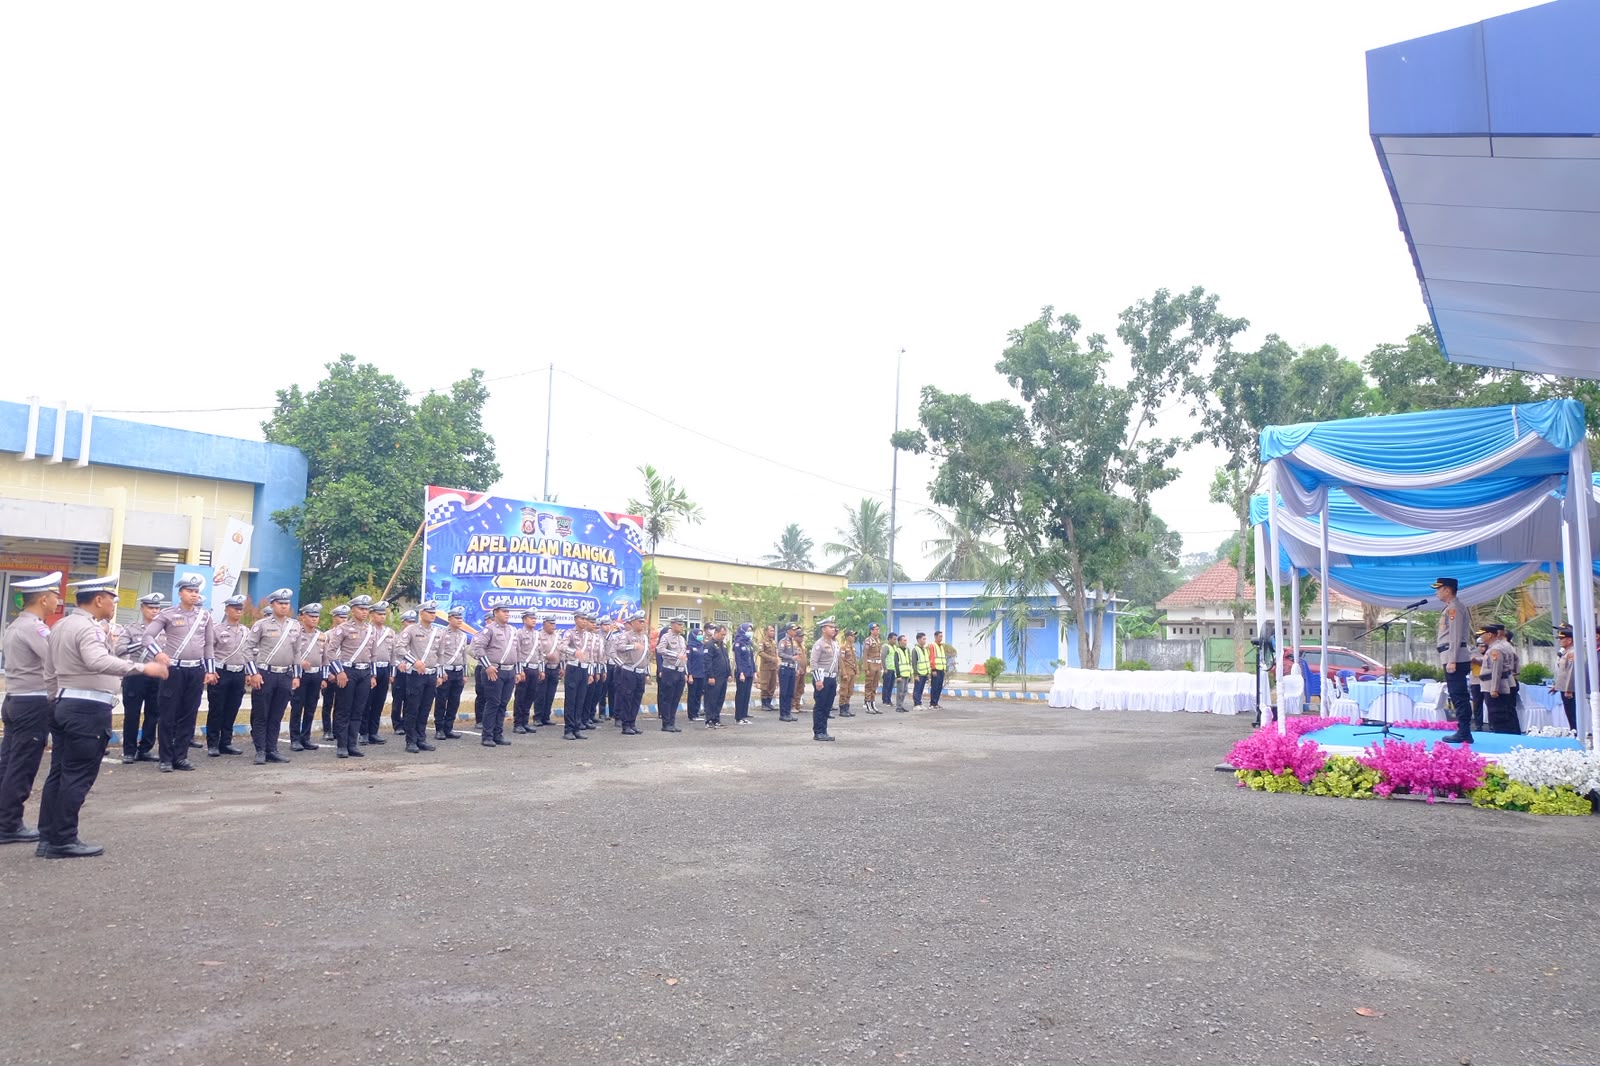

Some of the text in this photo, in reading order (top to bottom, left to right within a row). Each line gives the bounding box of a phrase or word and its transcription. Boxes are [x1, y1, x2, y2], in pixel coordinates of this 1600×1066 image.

[466, 535, 616, 566] APEL DALAM RANGKA
[452, 555, 624, 587] HARI LALU LINTAS KE 71
[515, 578, 573, 590] TAHUN 2026
[487, 595, 595, 610] SATLANTAS POLRES OKI
